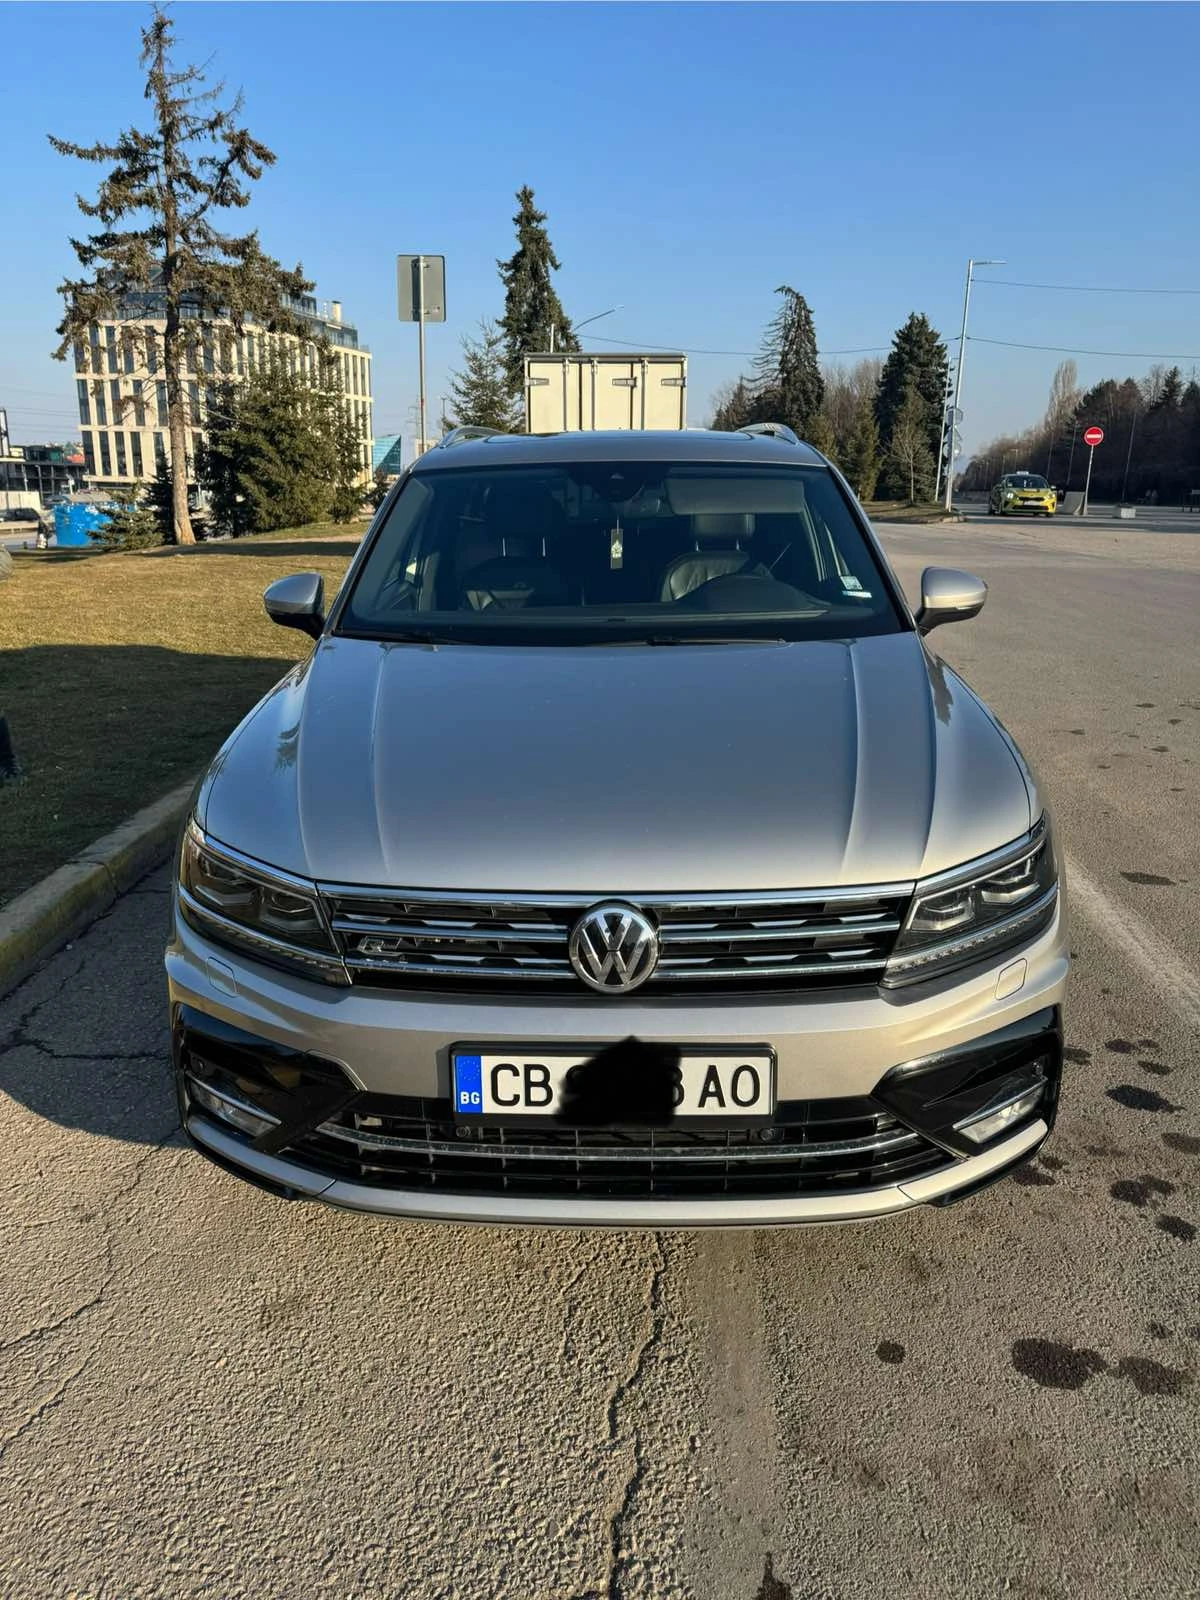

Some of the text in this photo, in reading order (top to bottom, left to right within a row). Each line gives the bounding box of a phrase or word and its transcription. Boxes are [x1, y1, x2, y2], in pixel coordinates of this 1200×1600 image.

[575, 906, 653, 988] VW
[460, 1091, 481, 1105] BG
[490, 1064, 554, 1107] CB
[697, 1065, 761, 1109] AO
